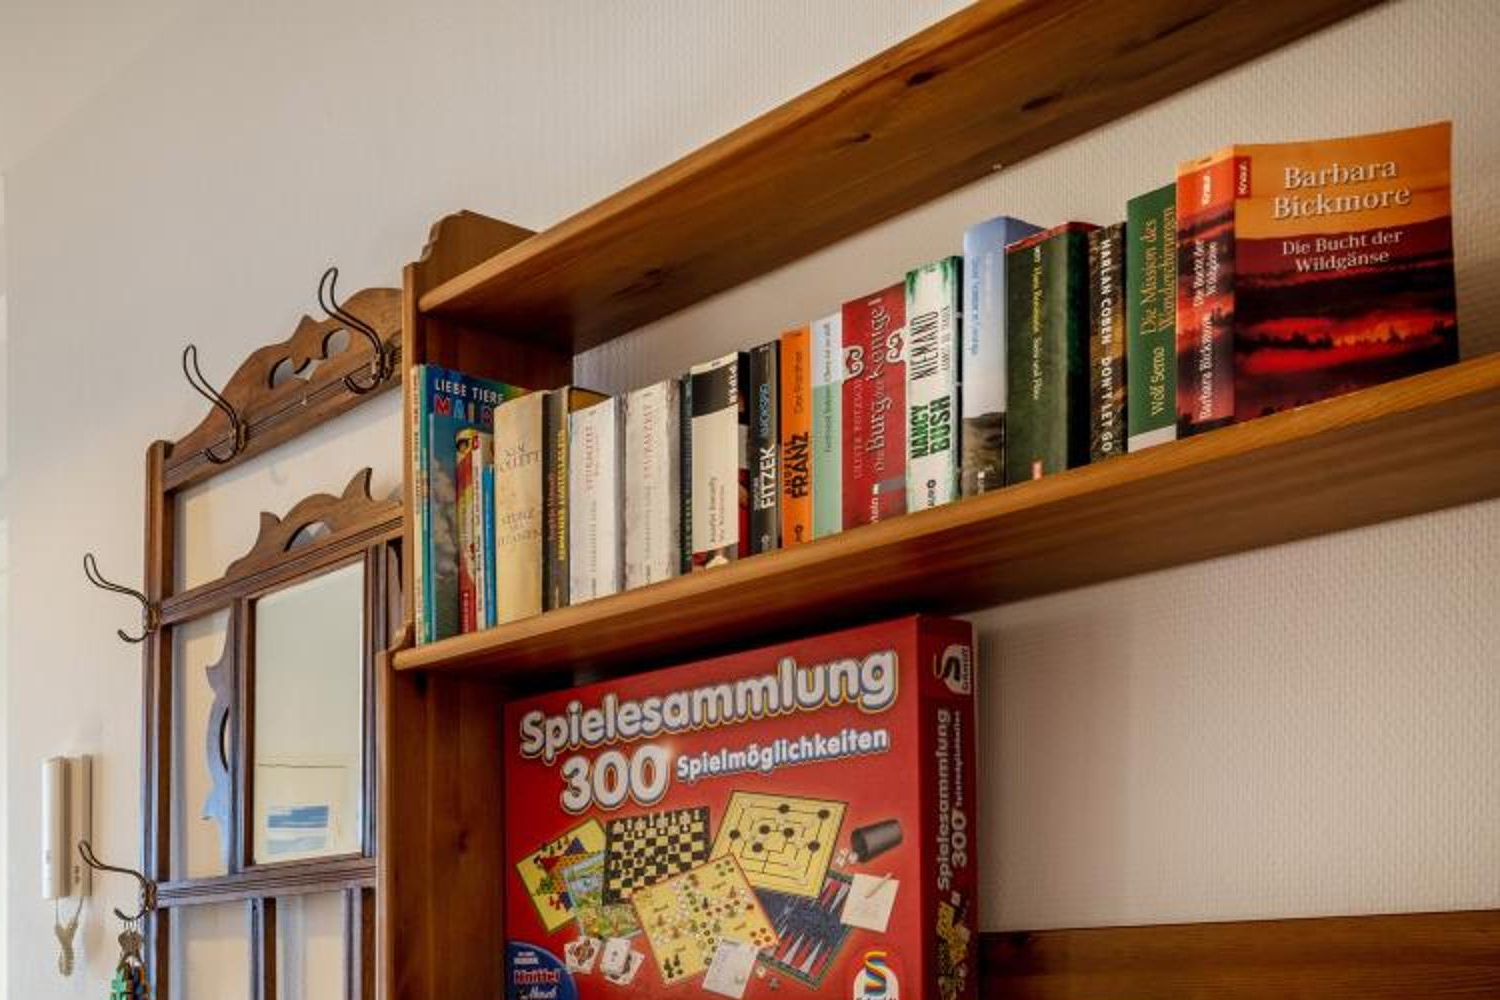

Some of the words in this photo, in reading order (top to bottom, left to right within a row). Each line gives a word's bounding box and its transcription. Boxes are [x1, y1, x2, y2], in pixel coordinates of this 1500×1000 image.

[1284, 160, 1397, 190] Barbara
[1272, 186, 1411, 220] Bickmore
[1140, 219, 1156, 242] des
[1283, 240, 1313, 256] Die
[1315, 234, 1368, 253] Bucht
[1371, 229, 1403, 246] der
[1100, 239, 1112, 295] HARLAN
[1140, 247, 1157, 306] Mission
[1295, 250, 1390, 273] Wildgänse
[1100, 298, 1112, 345] COBEN
[1140, 306, 1156, 335] Die
[435, 378, 467, 397] LIEBE
[1100, 356, 1112, 400] DON'T
[866, 398, 892, 452] Burg
[910, 404, 929, 459] NANCY
[930, 396, 951, 454] BUSH
[1100, 403, 1112, 427] LET
[790, 431, 808, 498] FRANZ
[1100, 430, 1112, 452] GO
[760, 444, 776, 509] FITZEK
[520, 650, 899, 765] Spielesammlung
[561, 744, 673, 814] 300
[677, 728, 889, 781] Spielmöglichkeiten
[937, 708, 951, 891] Spielesammlung
[952, 808, 968, 866] 300
